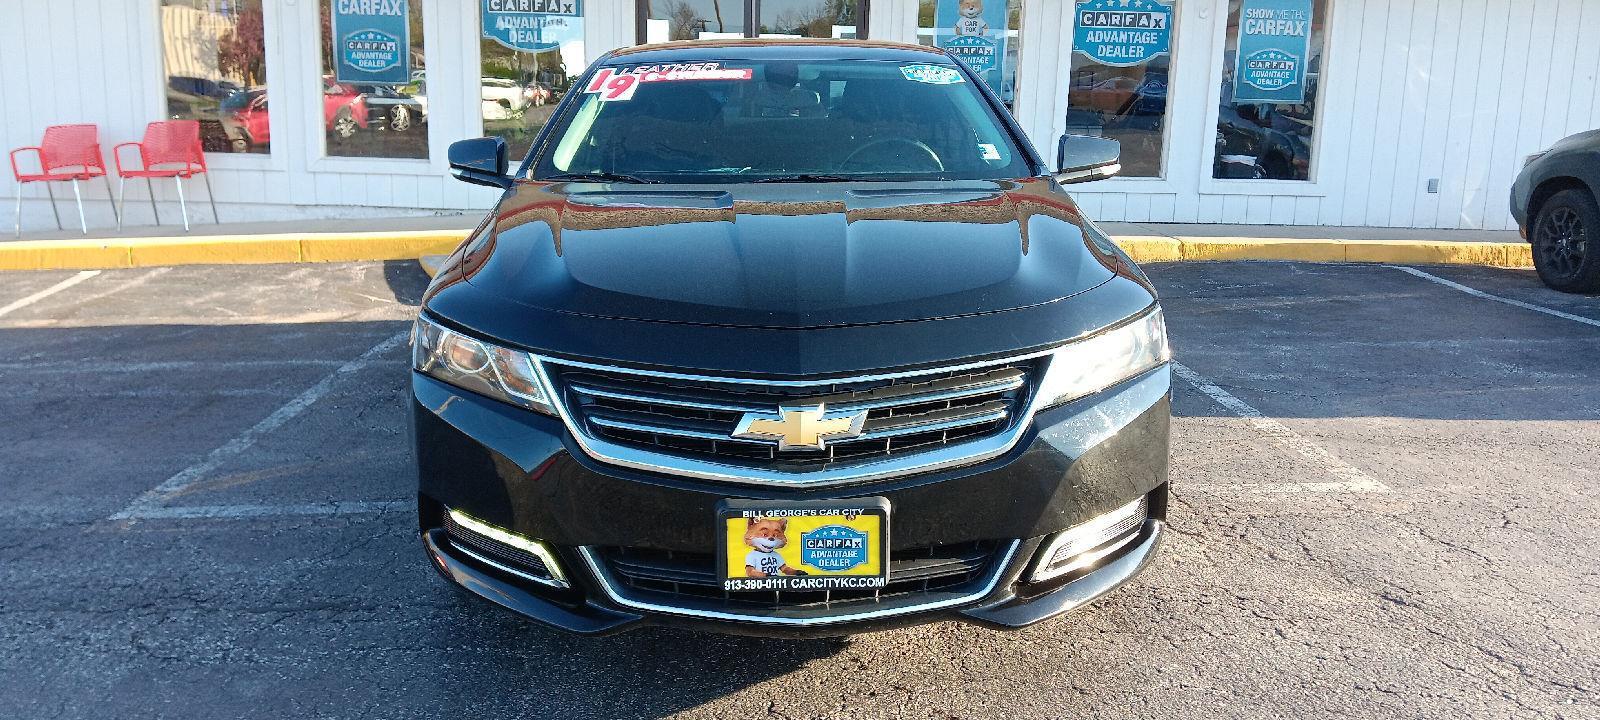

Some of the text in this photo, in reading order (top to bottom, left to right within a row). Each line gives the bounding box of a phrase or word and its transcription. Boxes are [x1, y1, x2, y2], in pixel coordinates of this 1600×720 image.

[338, 0, 402, 16] CARFAX
[489, 0, 574, 14] CARFAX
[1246, 8, 1274, 19] SHOW
[1083, 12, 1164, 29] CARFAX
[1245, 19, 1307, 37] CARFAX
[1086, 30, 1158, 44] ADVANTAGE
[348, 41, 396, 51] CARFAX
[1097, 44, 1145, 58] DEALER
[351, 51, 393, 61] ADVANTAGE
[358, 59, 386, 69] DEALER
[621, 62, 720, 76] LEATHER
[1249, 60, 1294, 70] CARFAX
[1250, 71, 1290, 79] ADVANTAGE
[589, 69, 636, 99] 19
[1257, 78, 1283, 86] DEALER
[743, 508, 865, 518] BILL GEORGE'S CAR CITY
[807, 539, 863, 549] CARFAX
[810, 550, 859, 559] ADVANTAGE
[760, 556, 778, 566] CAR
[818, 558, 851, 567] DEALER
[761, 565, 778, 576] FOX
[724, 577, 885, 590] 913-390-0111 CARCITYKC.COM
